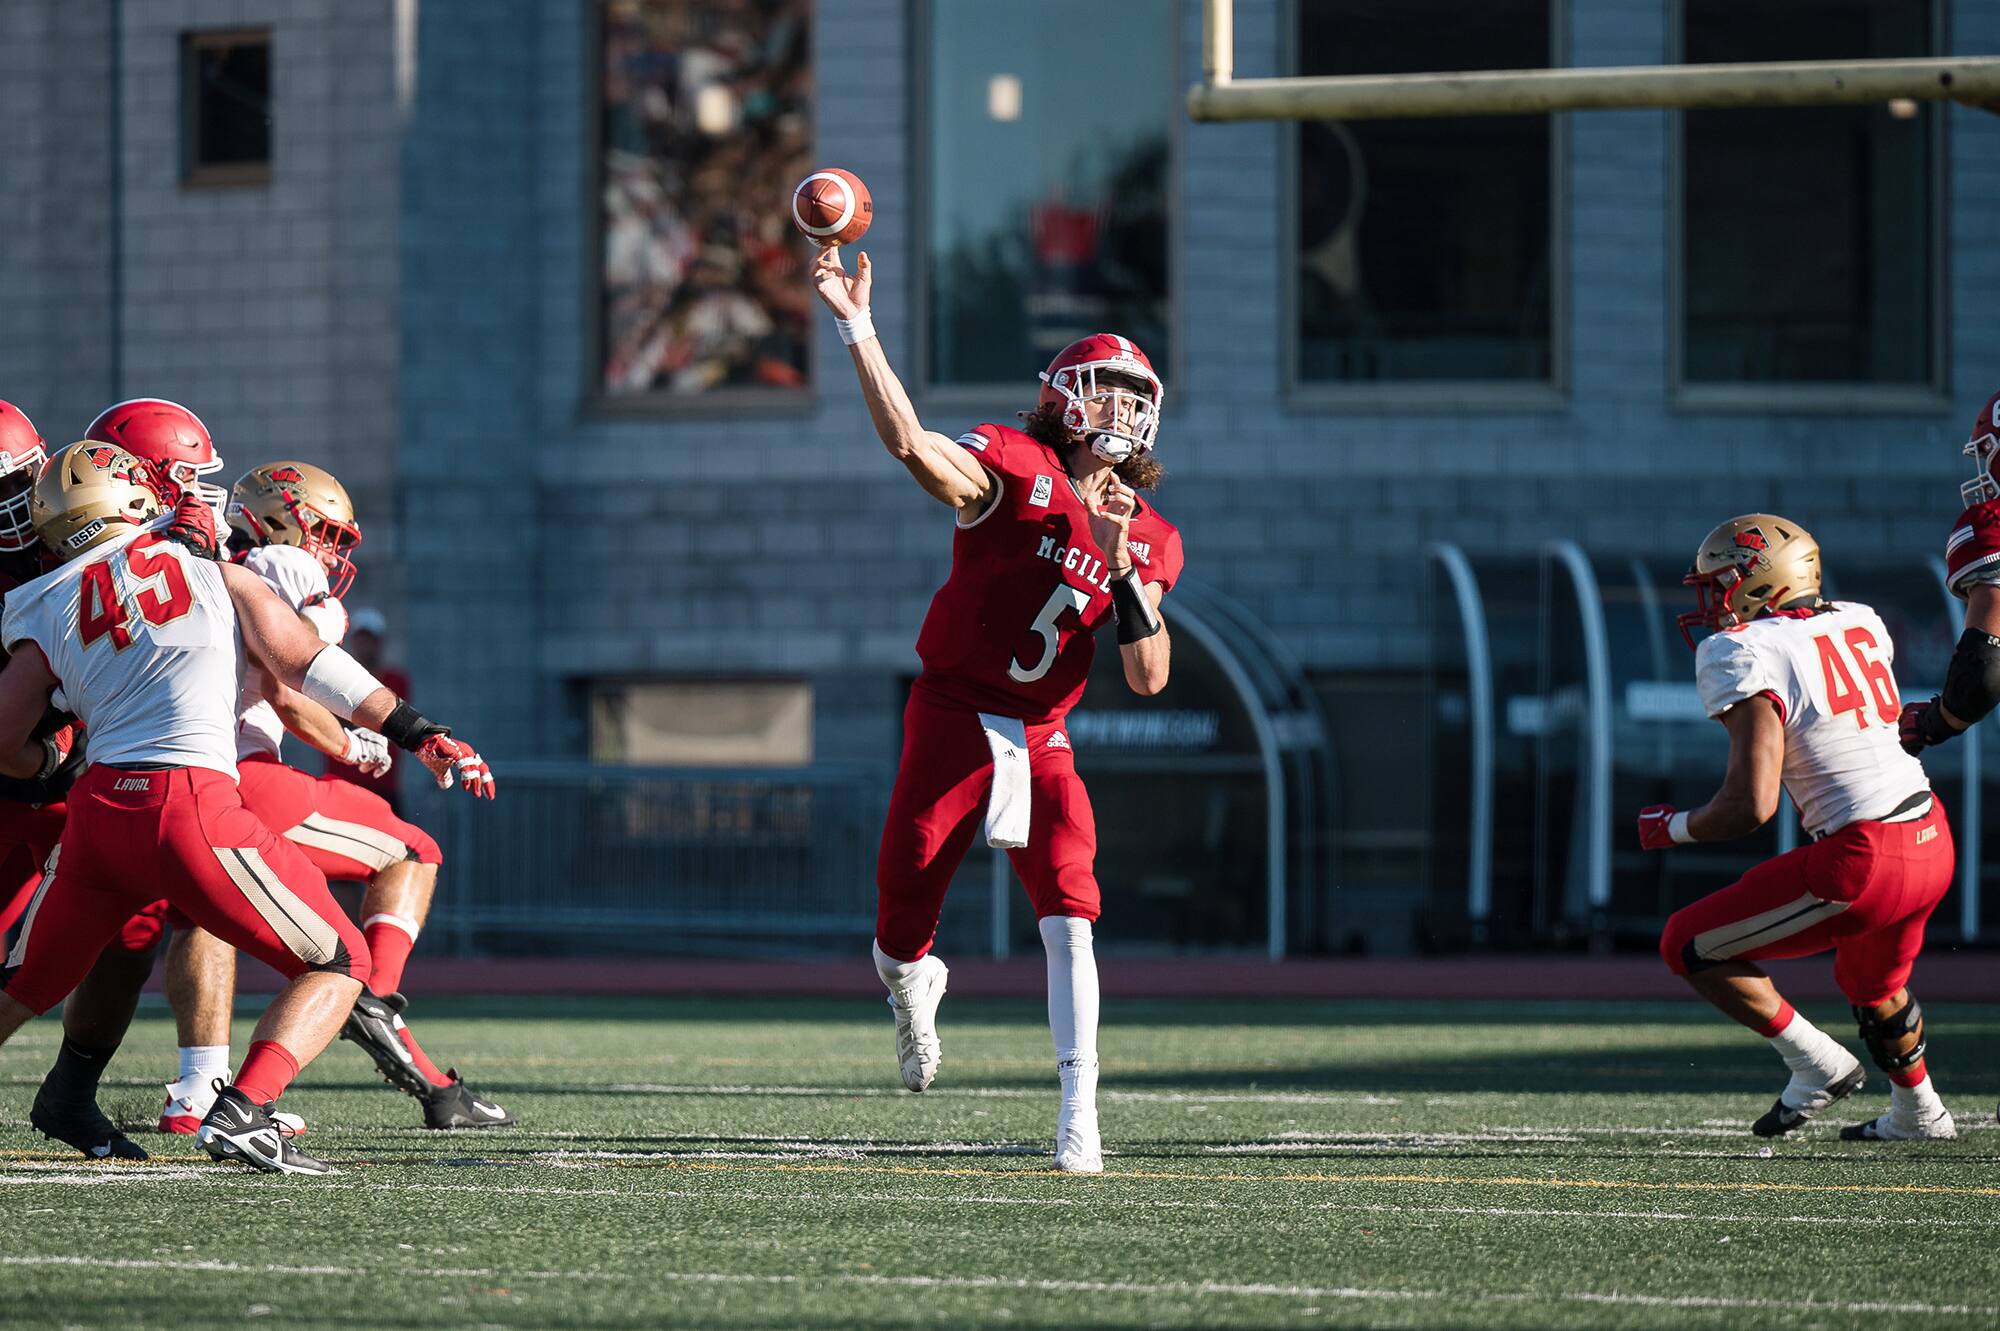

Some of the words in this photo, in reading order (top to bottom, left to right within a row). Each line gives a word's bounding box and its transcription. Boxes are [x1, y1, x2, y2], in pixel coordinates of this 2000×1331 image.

[70, 521, 104, 548] RSEQ
[78, 530, 196, 656] 45
[1008, 582, 1092, 683] 5
[1811, 626, 1903, 732] 46
[113, 777, 150, 791] LAVAL
